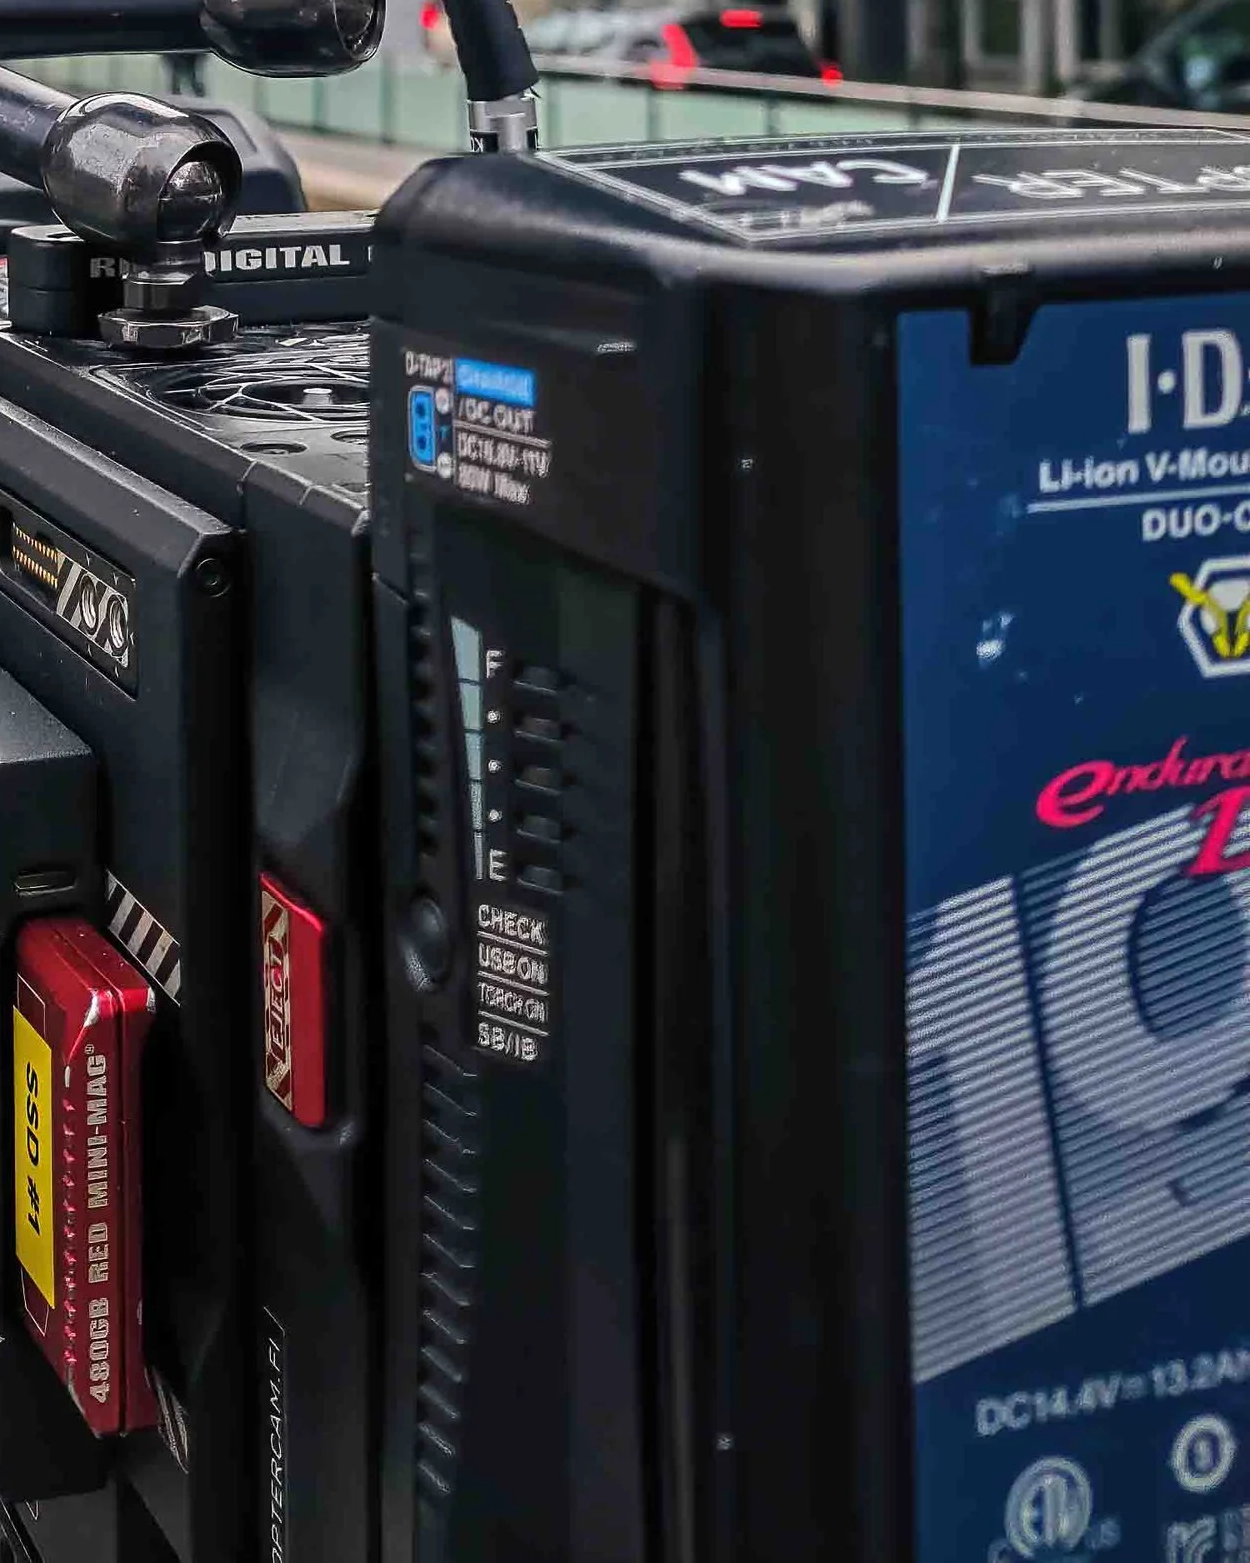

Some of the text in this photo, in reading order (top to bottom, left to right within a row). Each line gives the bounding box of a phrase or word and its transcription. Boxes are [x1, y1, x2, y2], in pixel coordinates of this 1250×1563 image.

[204, 244, 350, 273] DIGITAL
[1146, 446, 1250, 482] V-Mou
[485, 650, 503, 678] F
[489, 848, 507, 880] E
[478, 904, 546, 946] CHECK
[478, 942, 516, 975] USB
[269, 935, 287, 1052] EJECT
[24, 1060, 42, 1238] SSD #1
[87, 1221, 110, 1284] RED
[88, 1295, 111, 1405] 480GB
